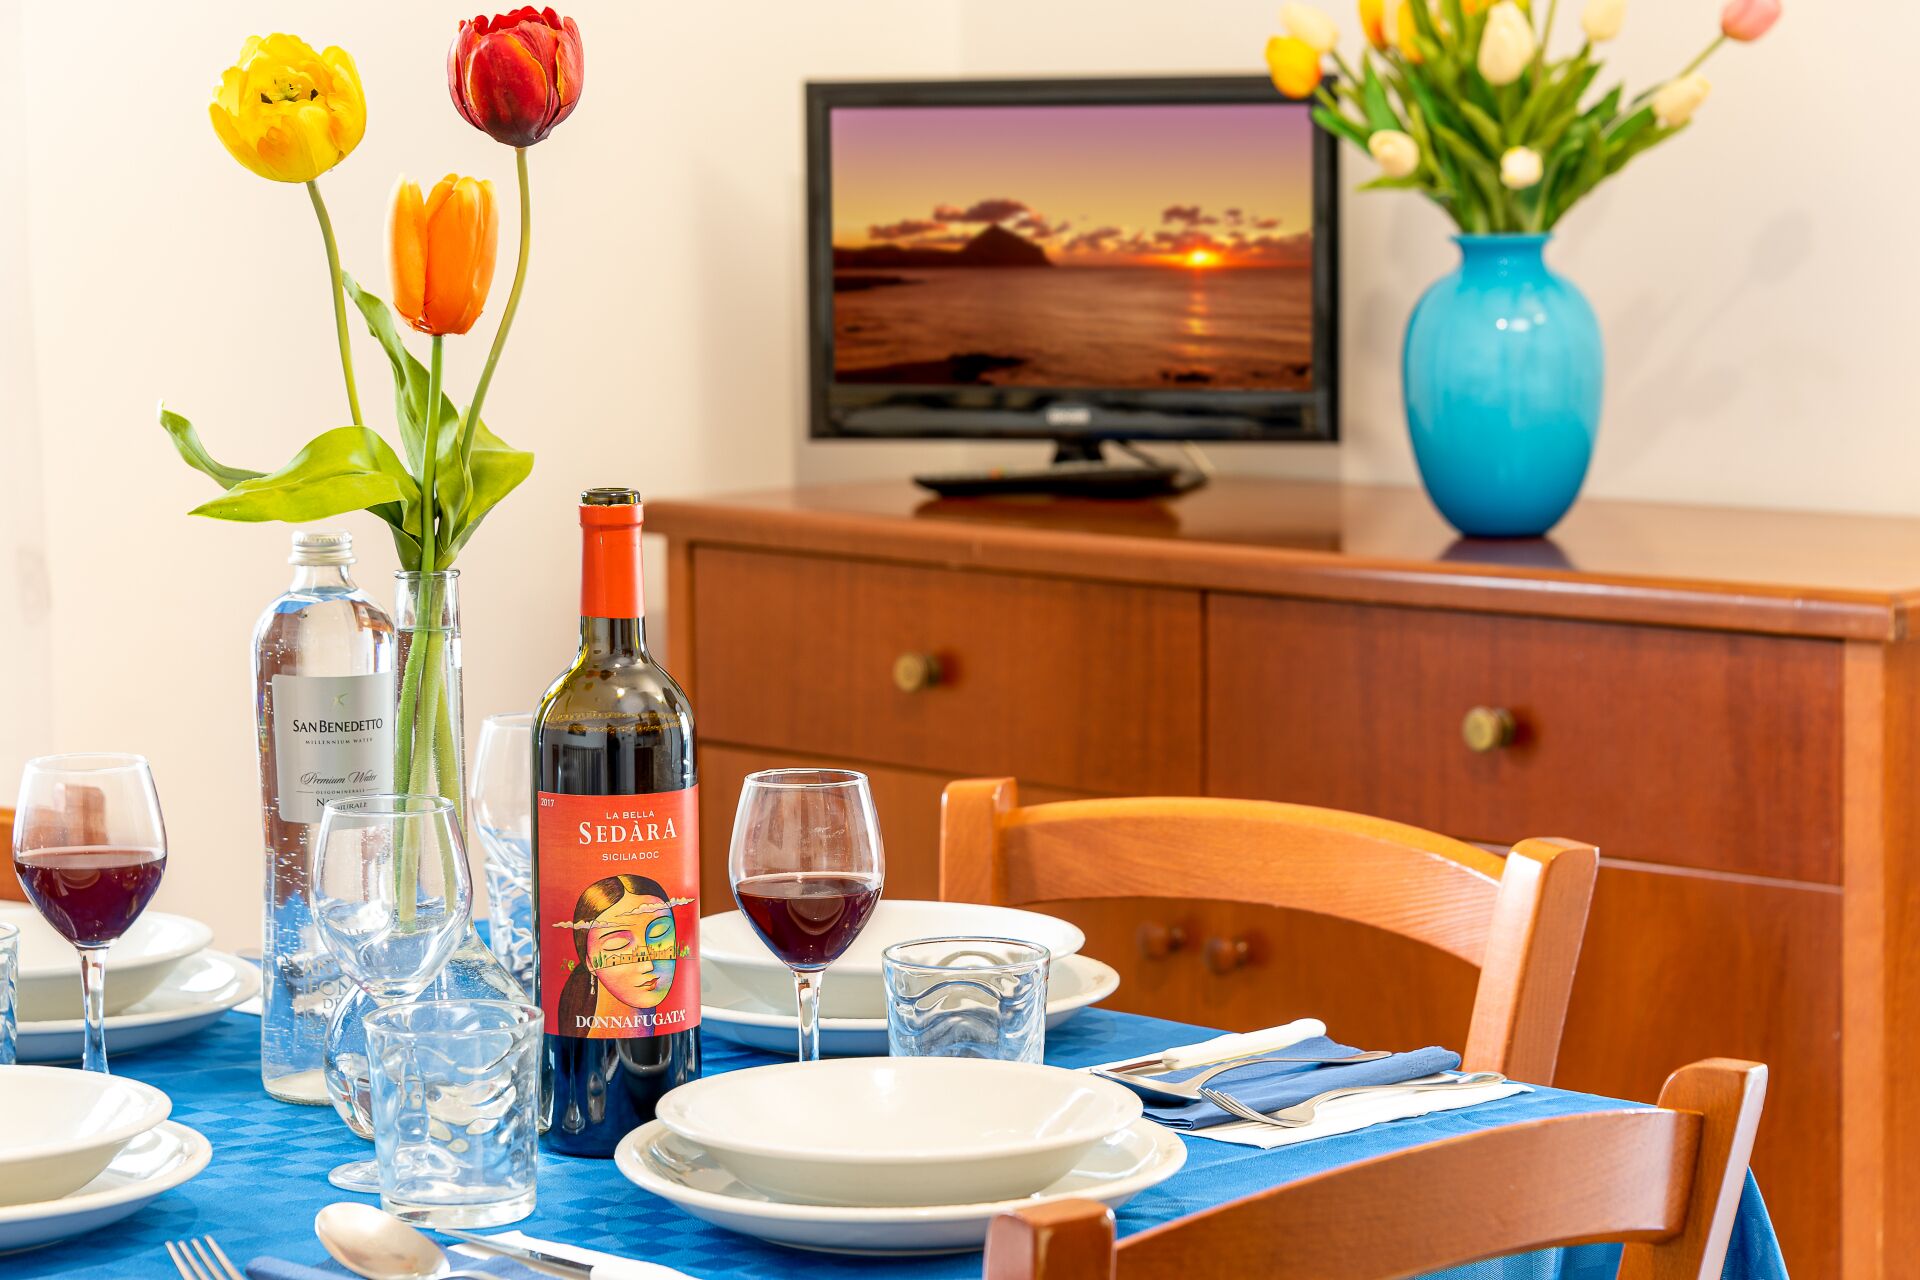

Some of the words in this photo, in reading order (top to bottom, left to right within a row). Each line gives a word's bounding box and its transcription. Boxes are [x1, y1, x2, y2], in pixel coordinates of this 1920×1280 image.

[293, 719, 317, 733] SAN
[319, 718, 383, 733] BENEDETTO
[300, 771, 346, 785] Premium
[347, 769, 377, 782] Water
[541, 797, 554, 807] 2017
[606, 811, 619, 820] LA
[622, 810, 655, 819] BELLA
[579, 817, 677, 845] SEDÀRA
[602, 853, 637, 861] SICILIA
[639, 851, 660, 860] DOC
[575, 1009, 686, 1028] DONNAFUGATA
